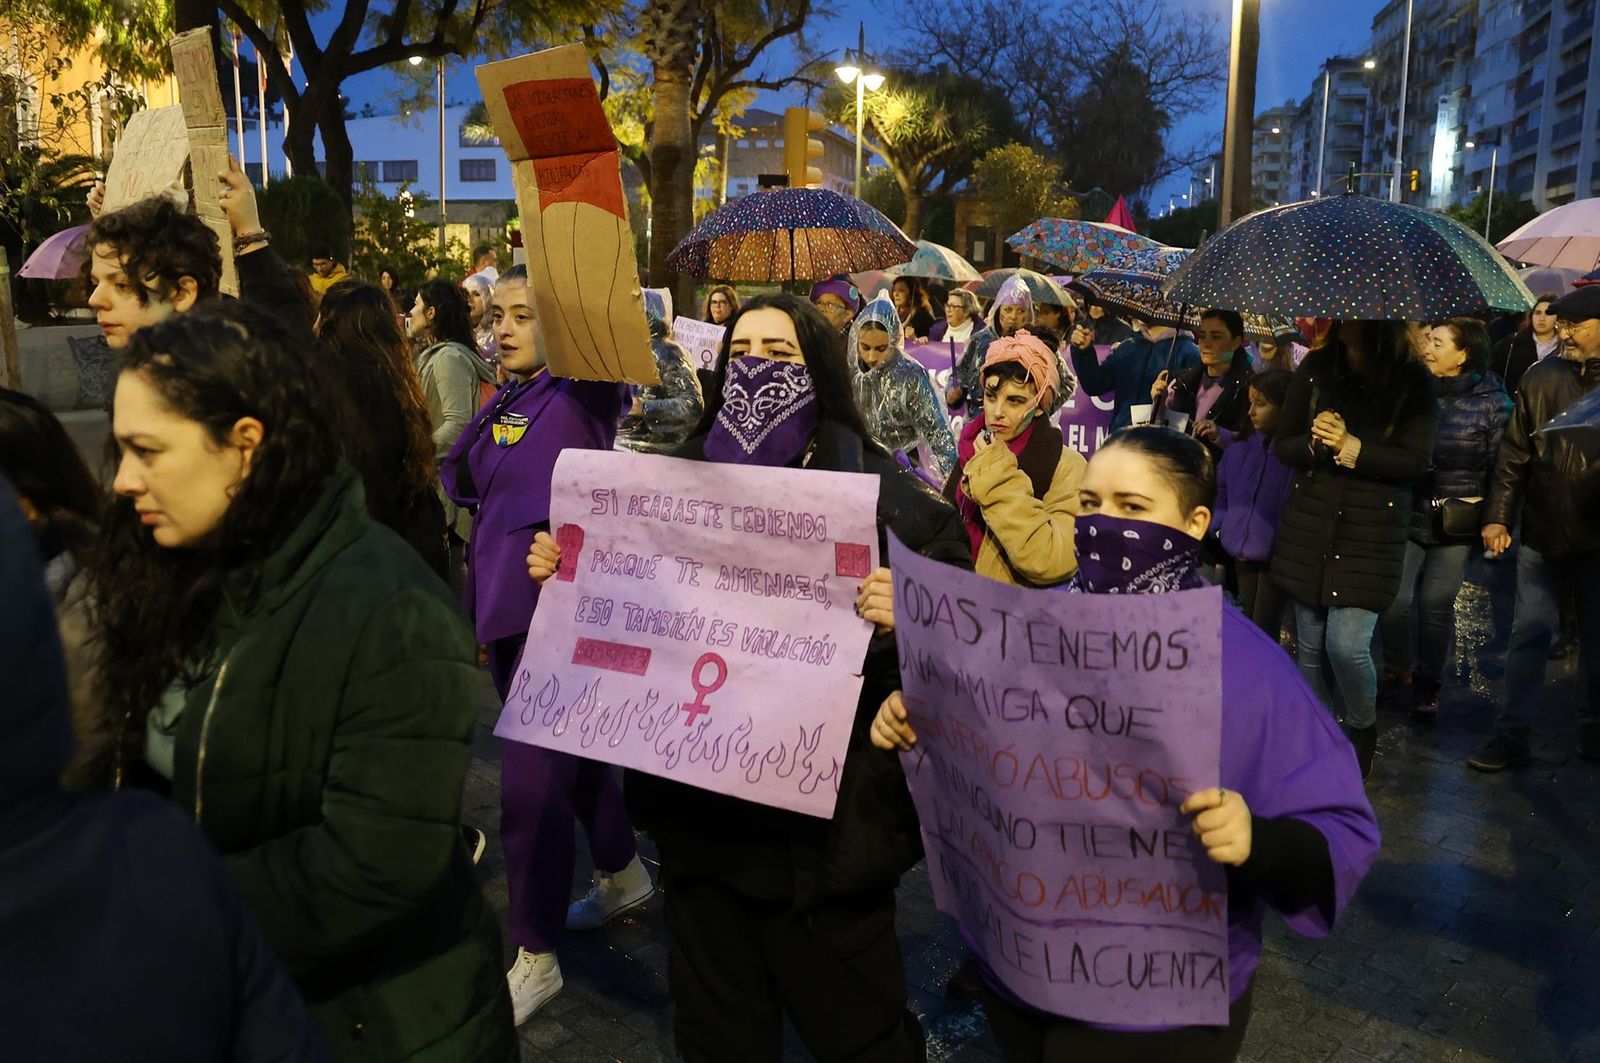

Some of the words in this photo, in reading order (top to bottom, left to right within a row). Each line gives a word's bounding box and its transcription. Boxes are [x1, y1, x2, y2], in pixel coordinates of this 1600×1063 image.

[1068, 424, 1089, 453] EL
[627, 495, 724, 529] ACABASTE
[731, 506, 827, 542] CEDIENDO
[591, 550, 662, 580] PORQUE
[675, 556, 703, 587] TE
[575, 596, 613, 626] ESO
[623, 602, 706, 642] TAMBIÉN
[706, 620, 737, 647] ES
[741, 627, 836, 666] VIOLACIÓN
[954, 669, 1049, 724] AMIGA
[1065, 694, 1164, 743] QUE
[1040, 818, 1198, 864] TIENE
[1054, 872, 1226, 921] ABUSADOR
